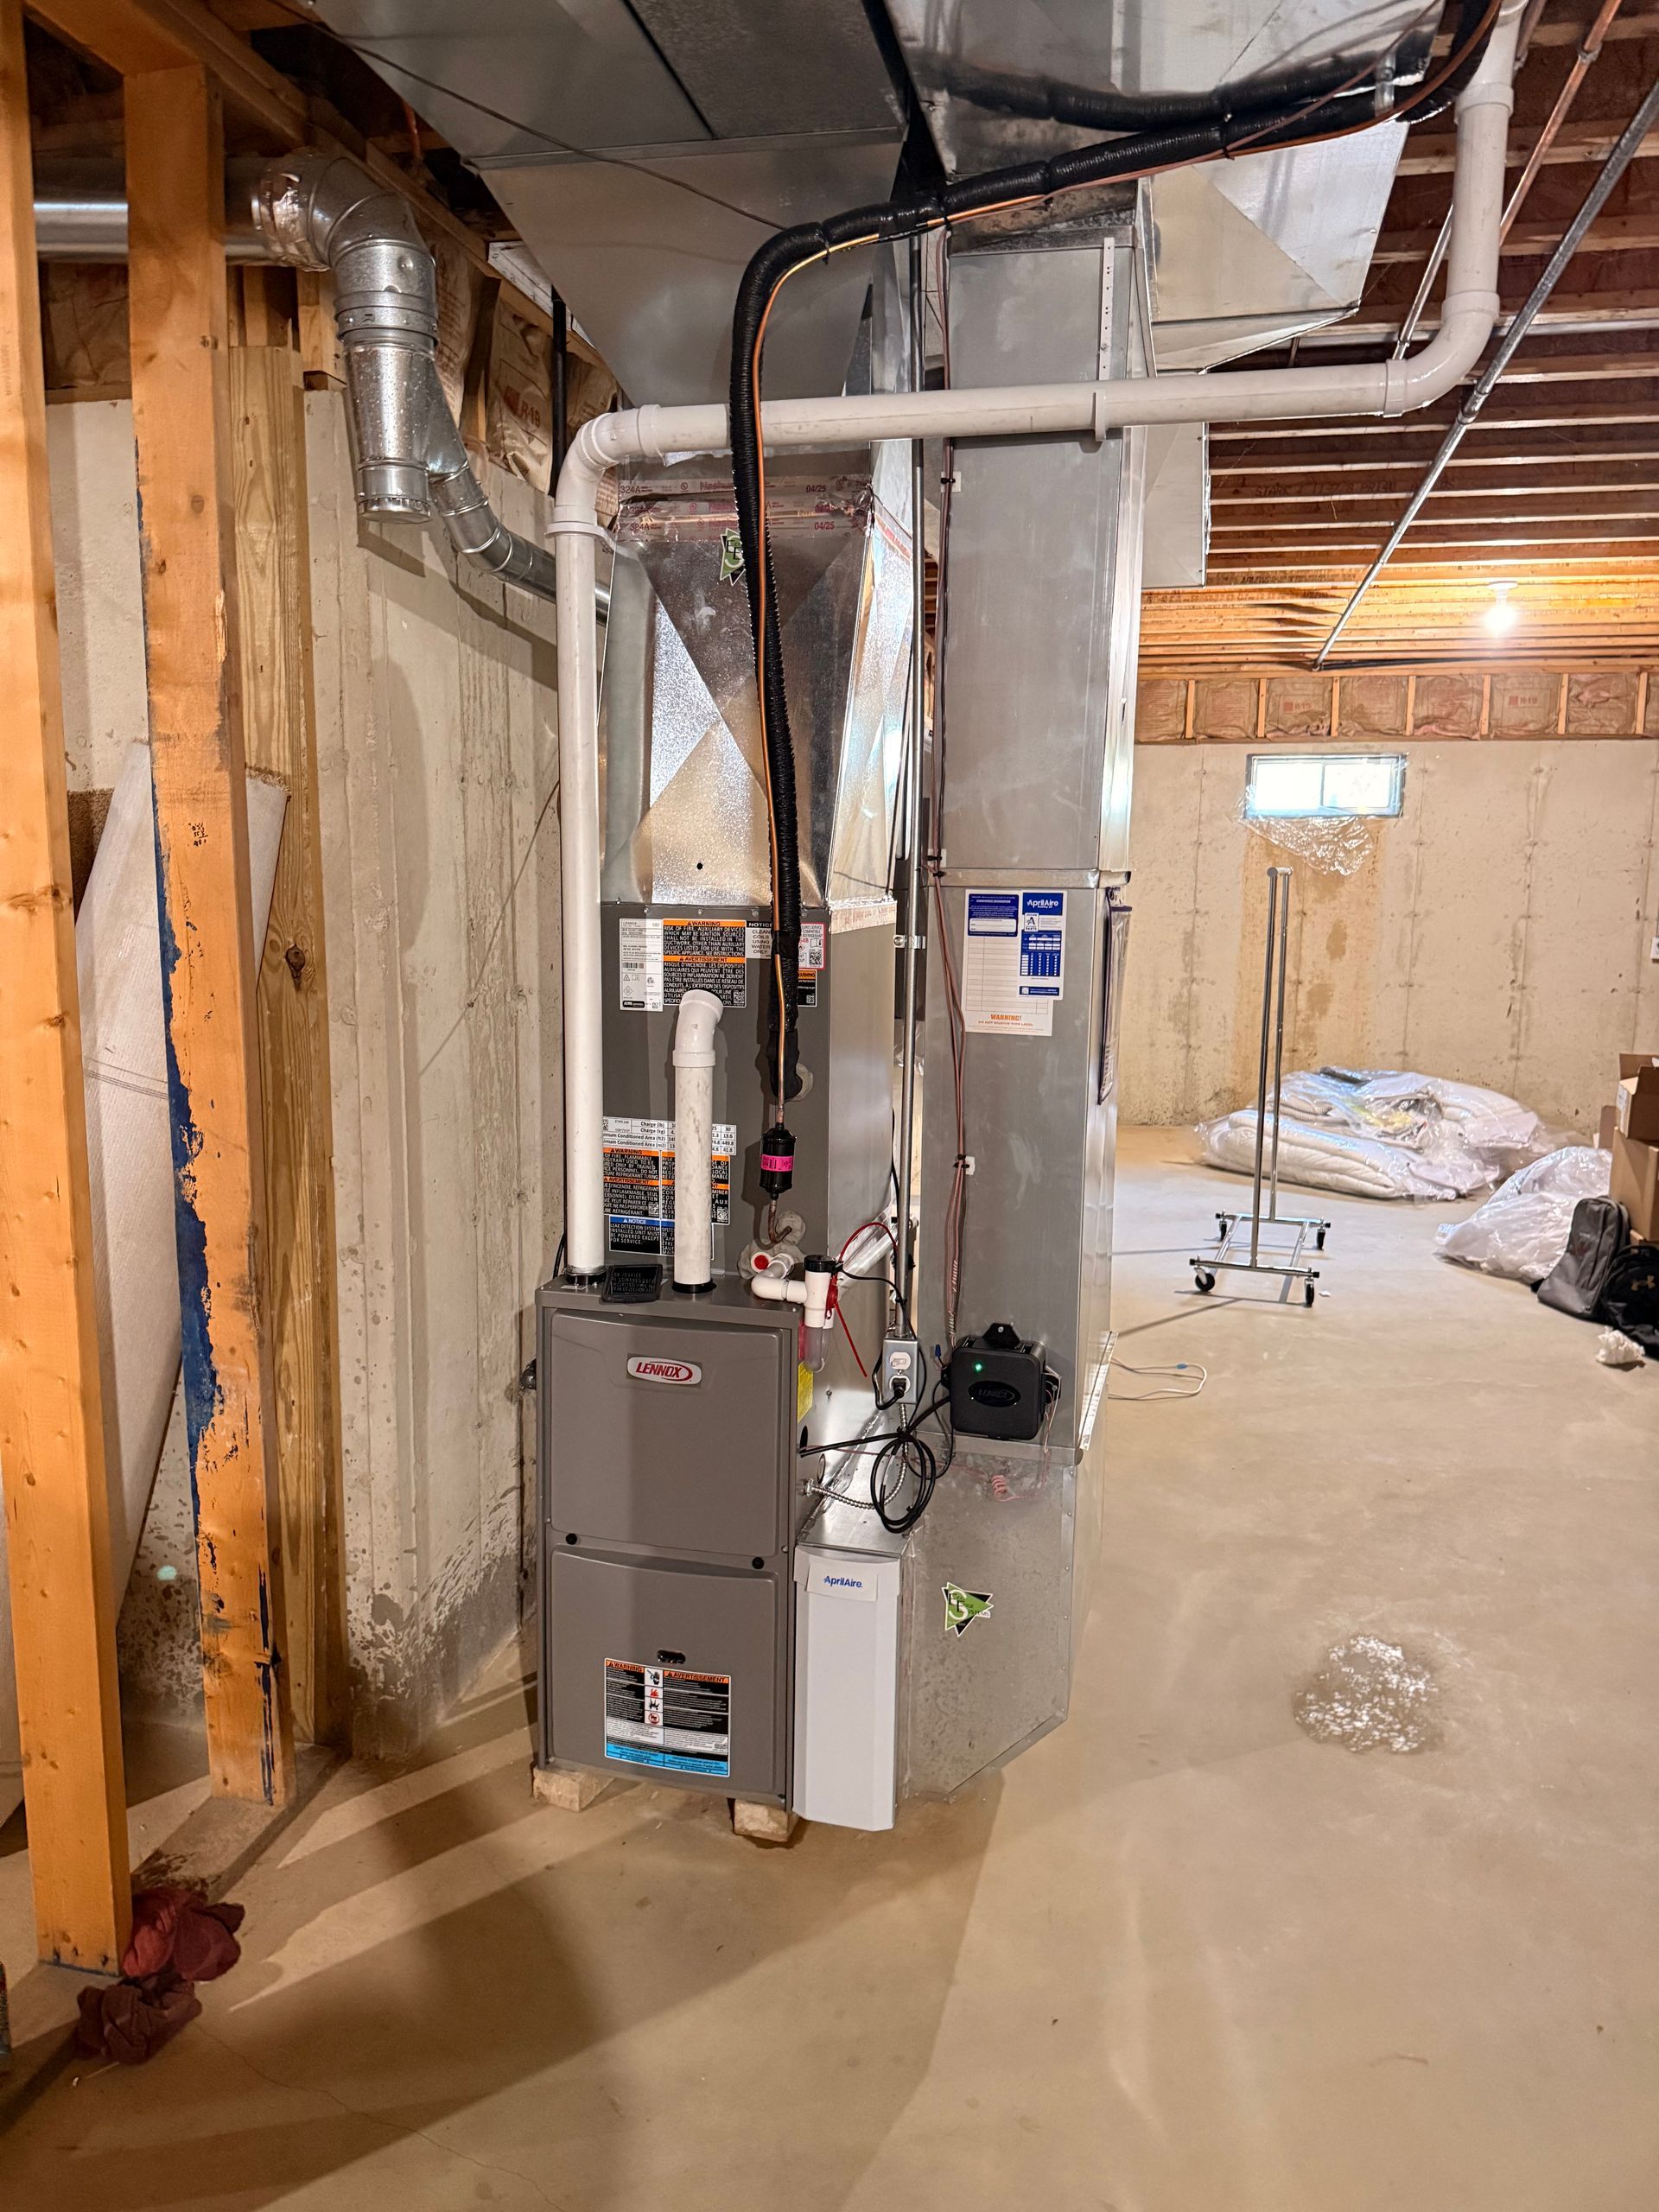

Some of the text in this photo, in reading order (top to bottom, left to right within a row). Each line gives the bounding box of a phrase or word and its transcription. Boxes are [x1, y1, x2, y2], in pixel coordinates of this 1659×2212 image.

[815, 522, 835, 531] 04/25
[636, 1363, 682, 1378] LENNOX
[823, 1576, 861, 1587] AprilAire
[614, 1662, 643, 1673] WARNING
[674, 1673, 725, 1683] AVERTISSEMENT
